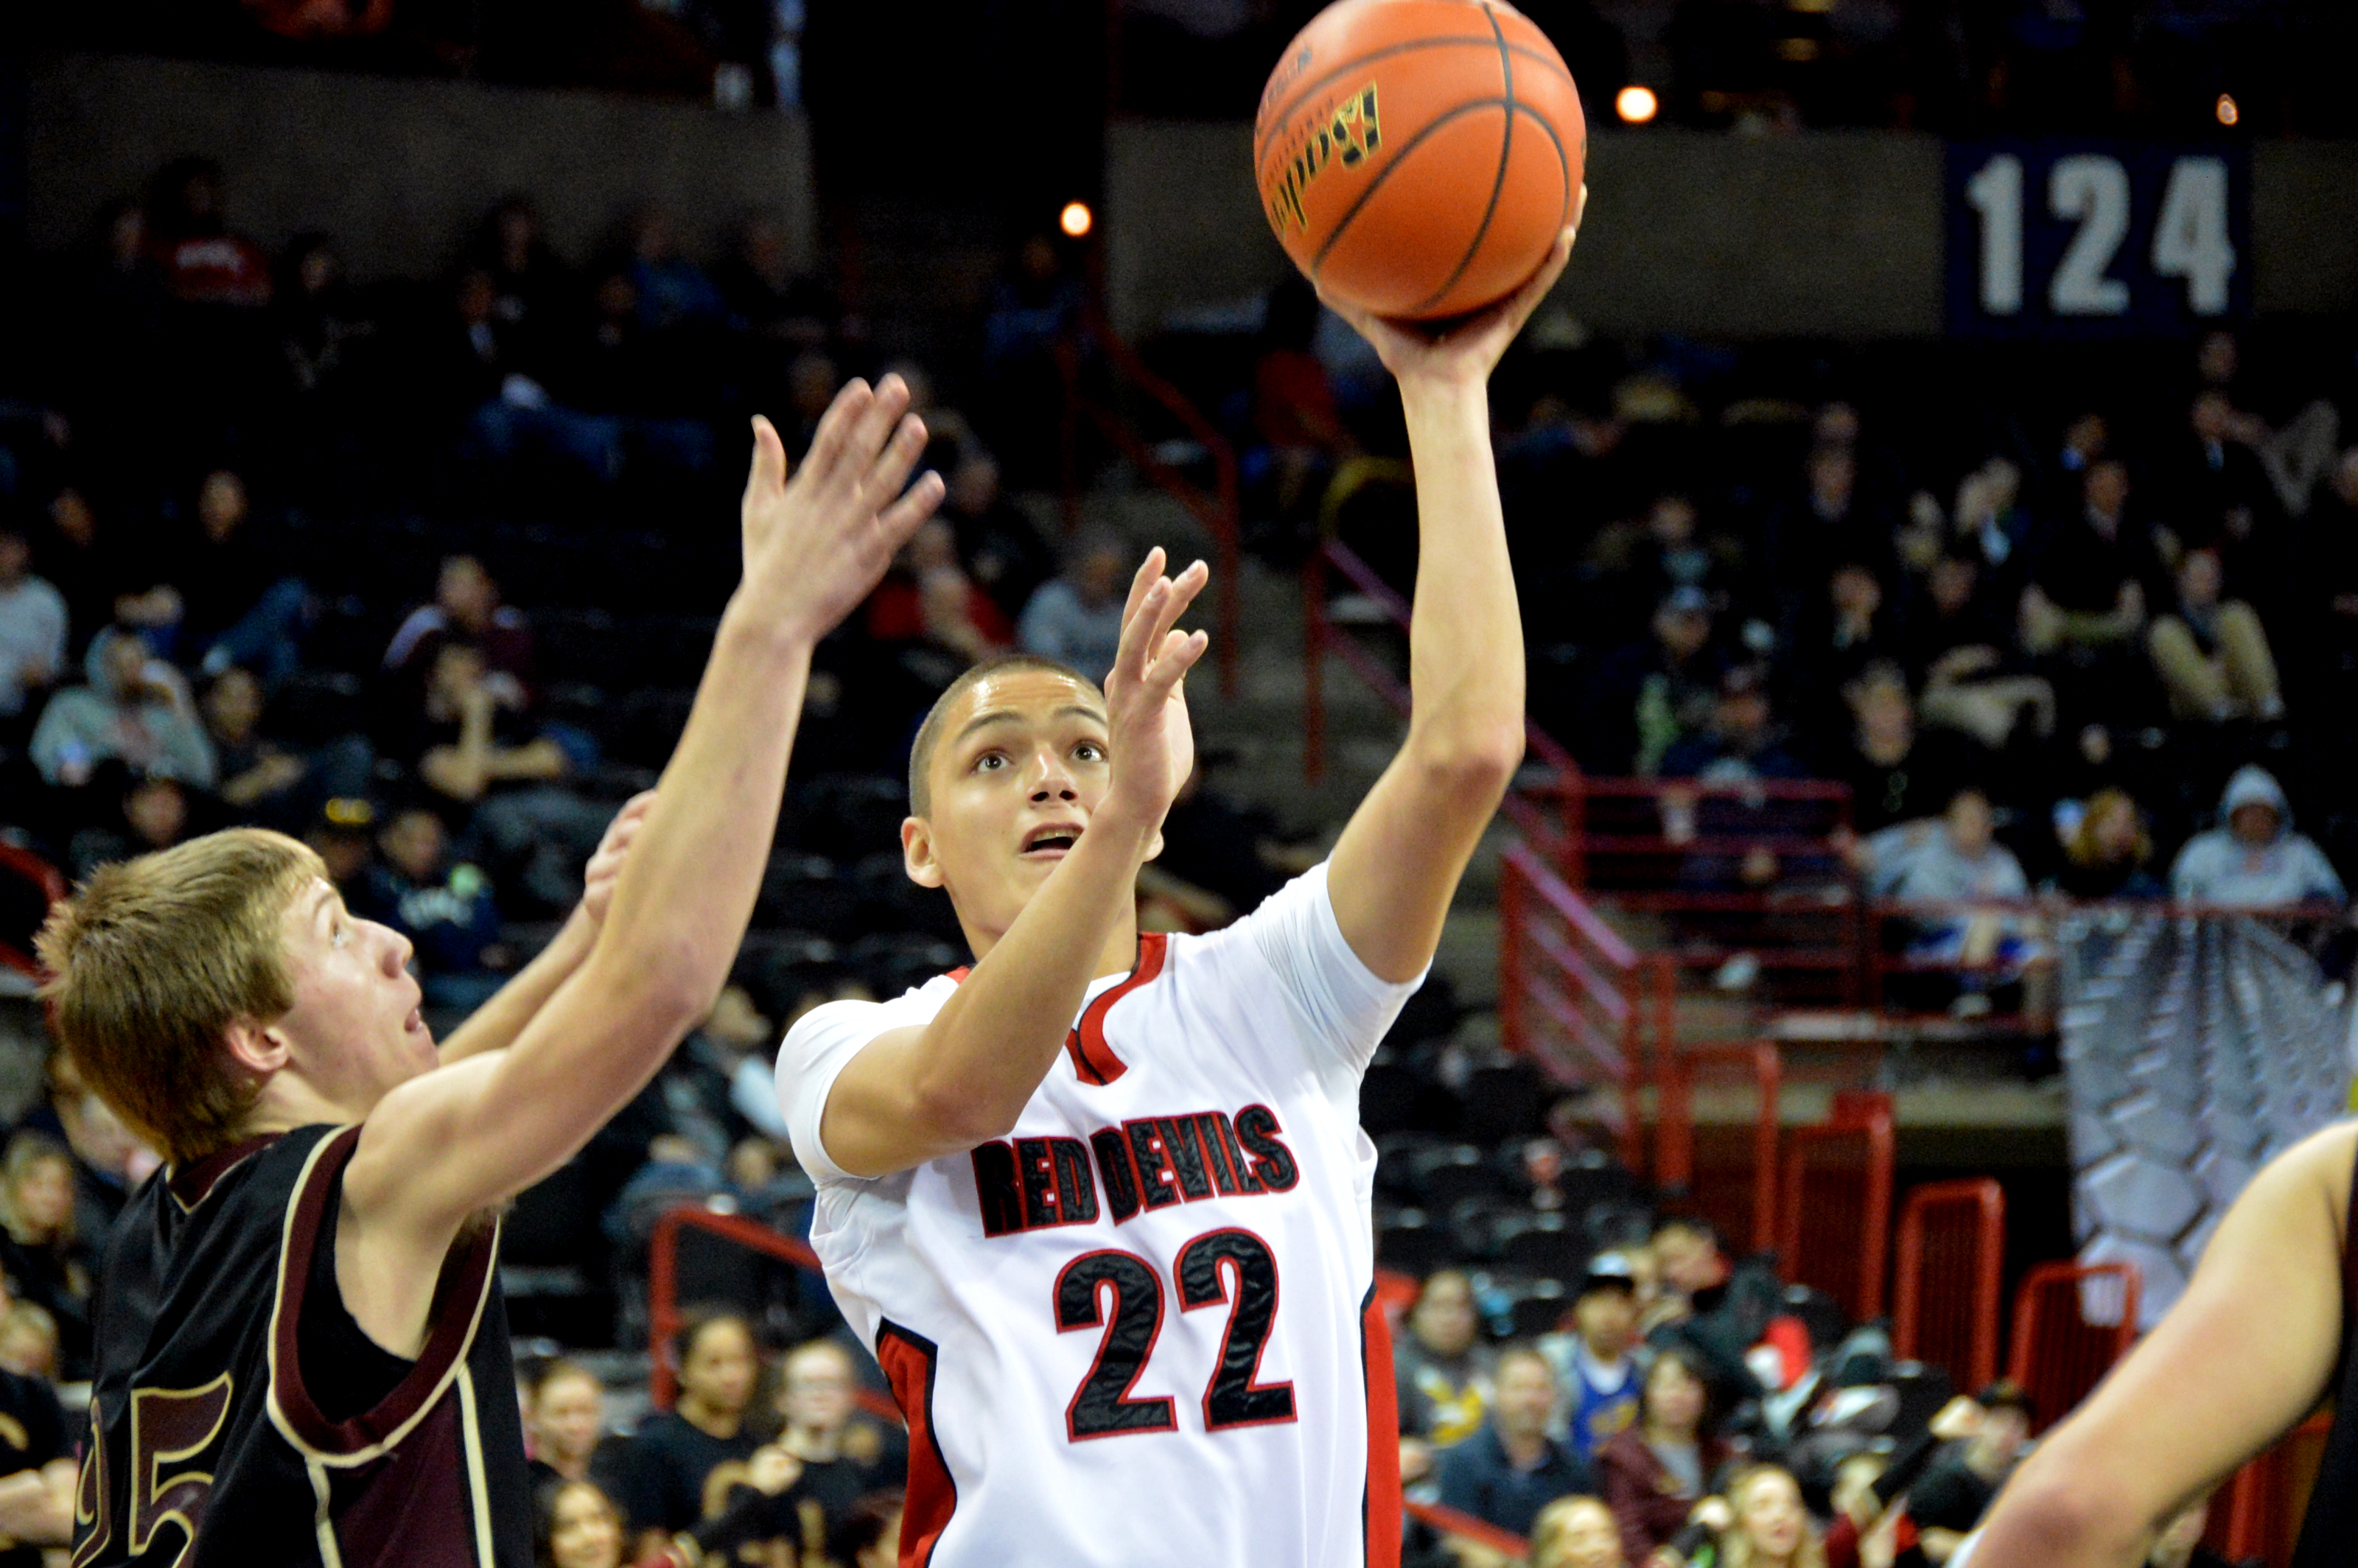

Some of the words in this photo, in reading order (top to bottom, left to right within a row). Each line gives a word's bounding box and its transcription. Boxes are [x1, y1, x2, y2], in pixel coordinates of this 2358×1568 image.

[1966, 153, 2236, 315] 124
[970, 1135, 1099, 1238] RED
[1090, 1103, 1299, 1226] DEVILS
[1052, 1227, 1298, 1443] 22
